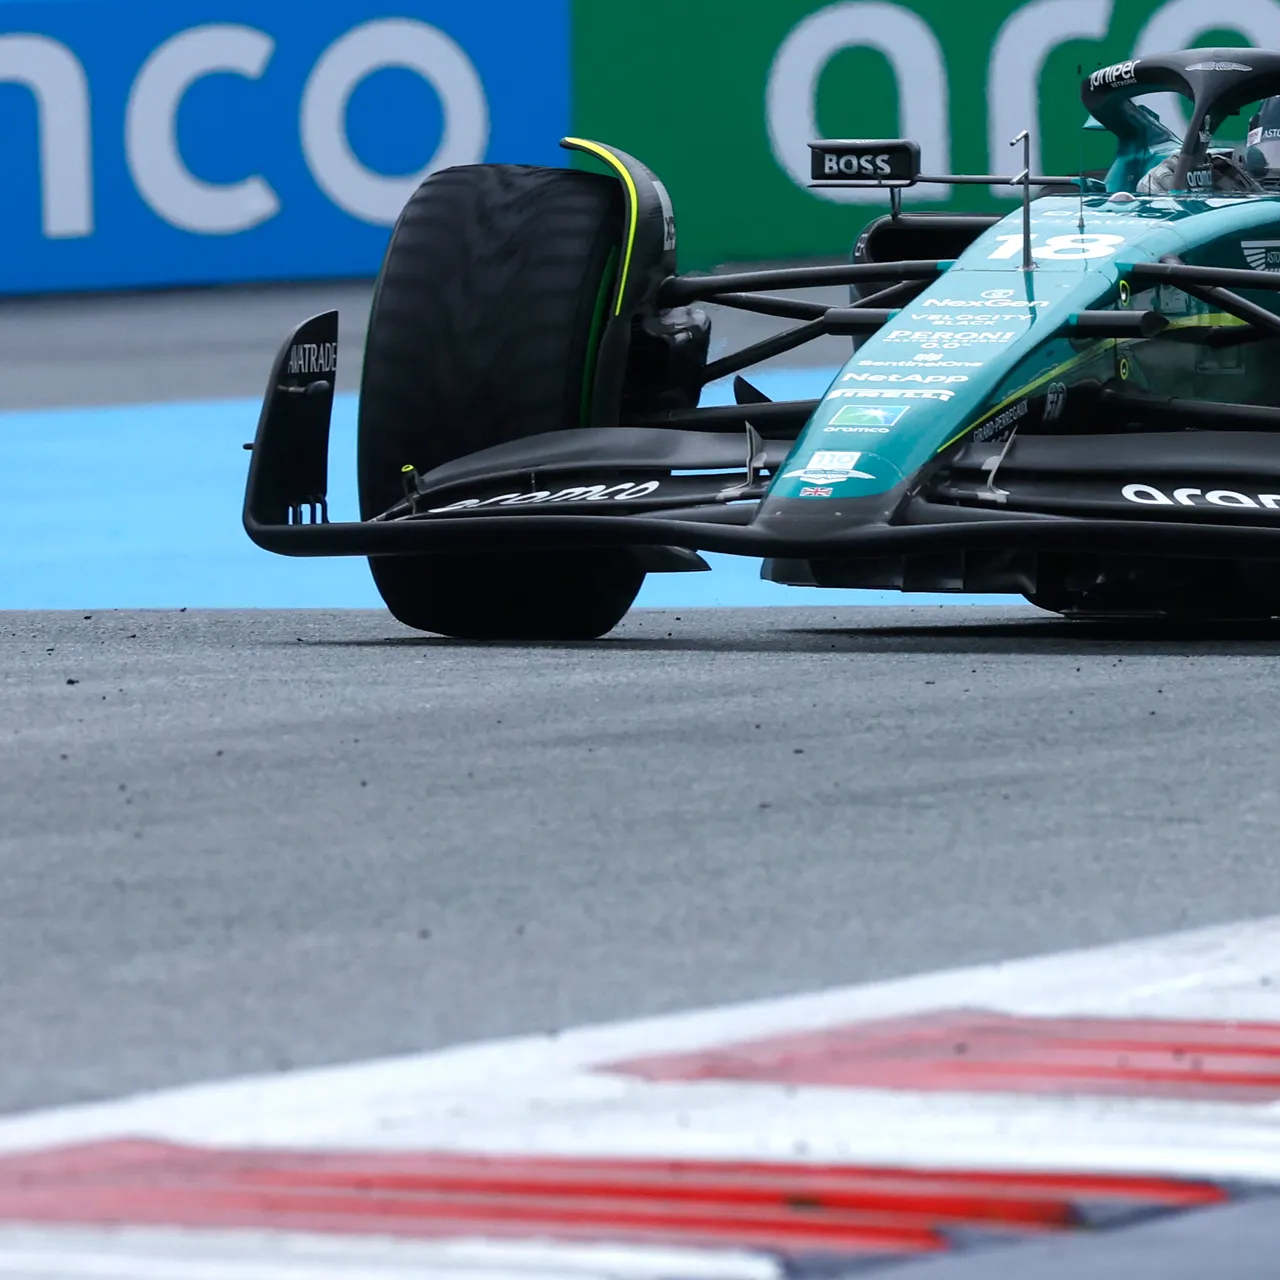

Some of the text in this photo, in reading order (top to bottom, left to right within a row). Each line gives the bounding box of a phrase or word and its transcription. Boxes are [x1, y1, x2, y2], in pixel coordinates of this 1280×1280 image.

[824, 153, 891, 175] BOSS
[986, 233, 1126, 260] 18
[922, 298, 1050, 308] NexGen
[886, 329, 1016, 340] PERONI
[287, 342, 337, 373] AVATRADE
[857, 359, 983, 367] SentinelOne
[842, 372, 969, 384] NetApp
[826, 388, 956, 402] PIRELLI
[823, 426, 890, 434] aramco
[428, 480, 660, 513] aramco
